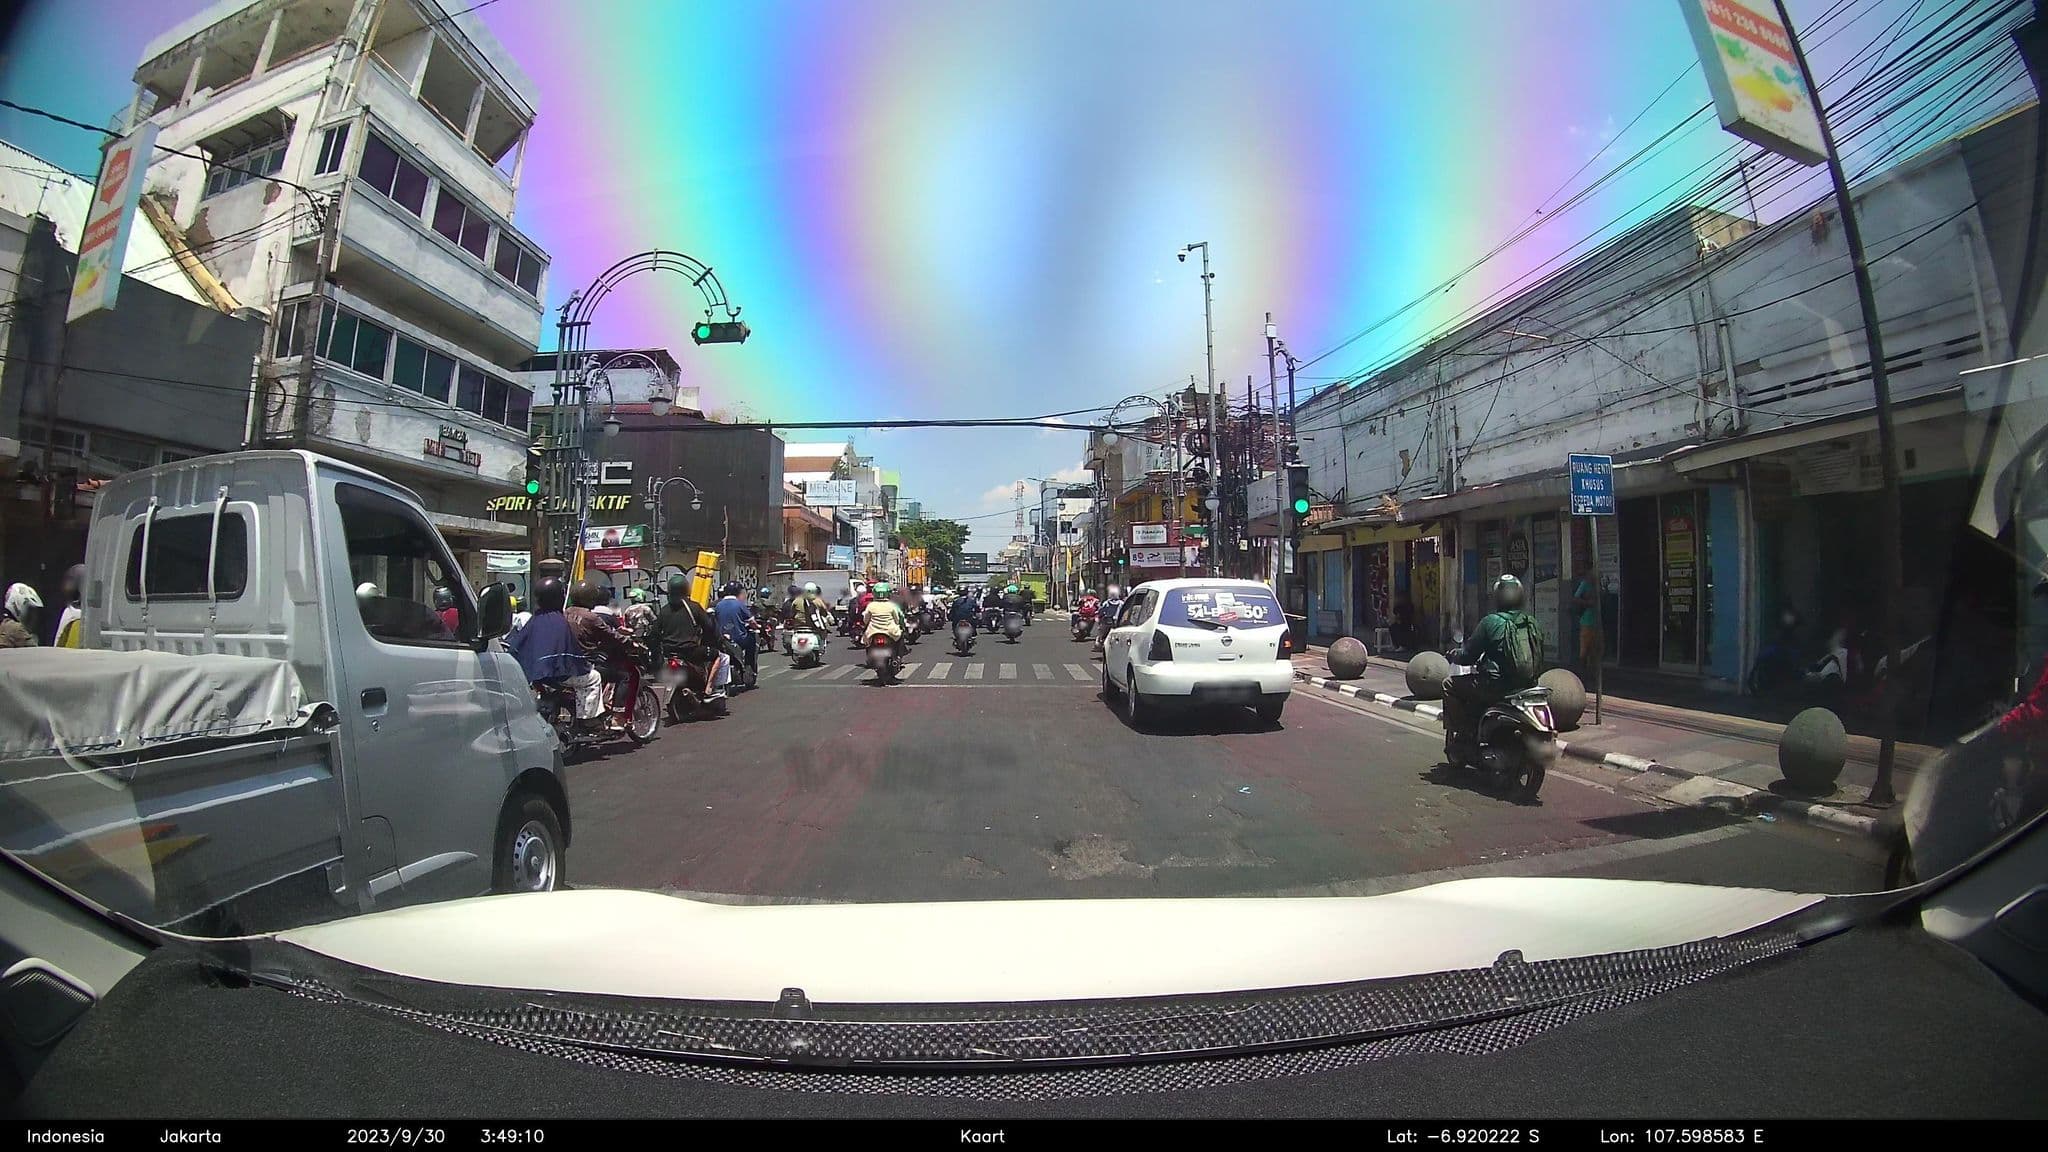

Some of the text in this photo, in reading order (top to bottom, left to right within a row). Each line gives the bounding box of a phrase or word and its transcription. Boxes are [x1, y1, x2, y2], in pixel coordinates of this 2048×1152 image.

[1572, 462, 1611, 474] RUANG HENTI
[1581, 478, 1604, 490] KHUSUS
[1573, 495, 1613, 507] SEPEDA MOTOR
